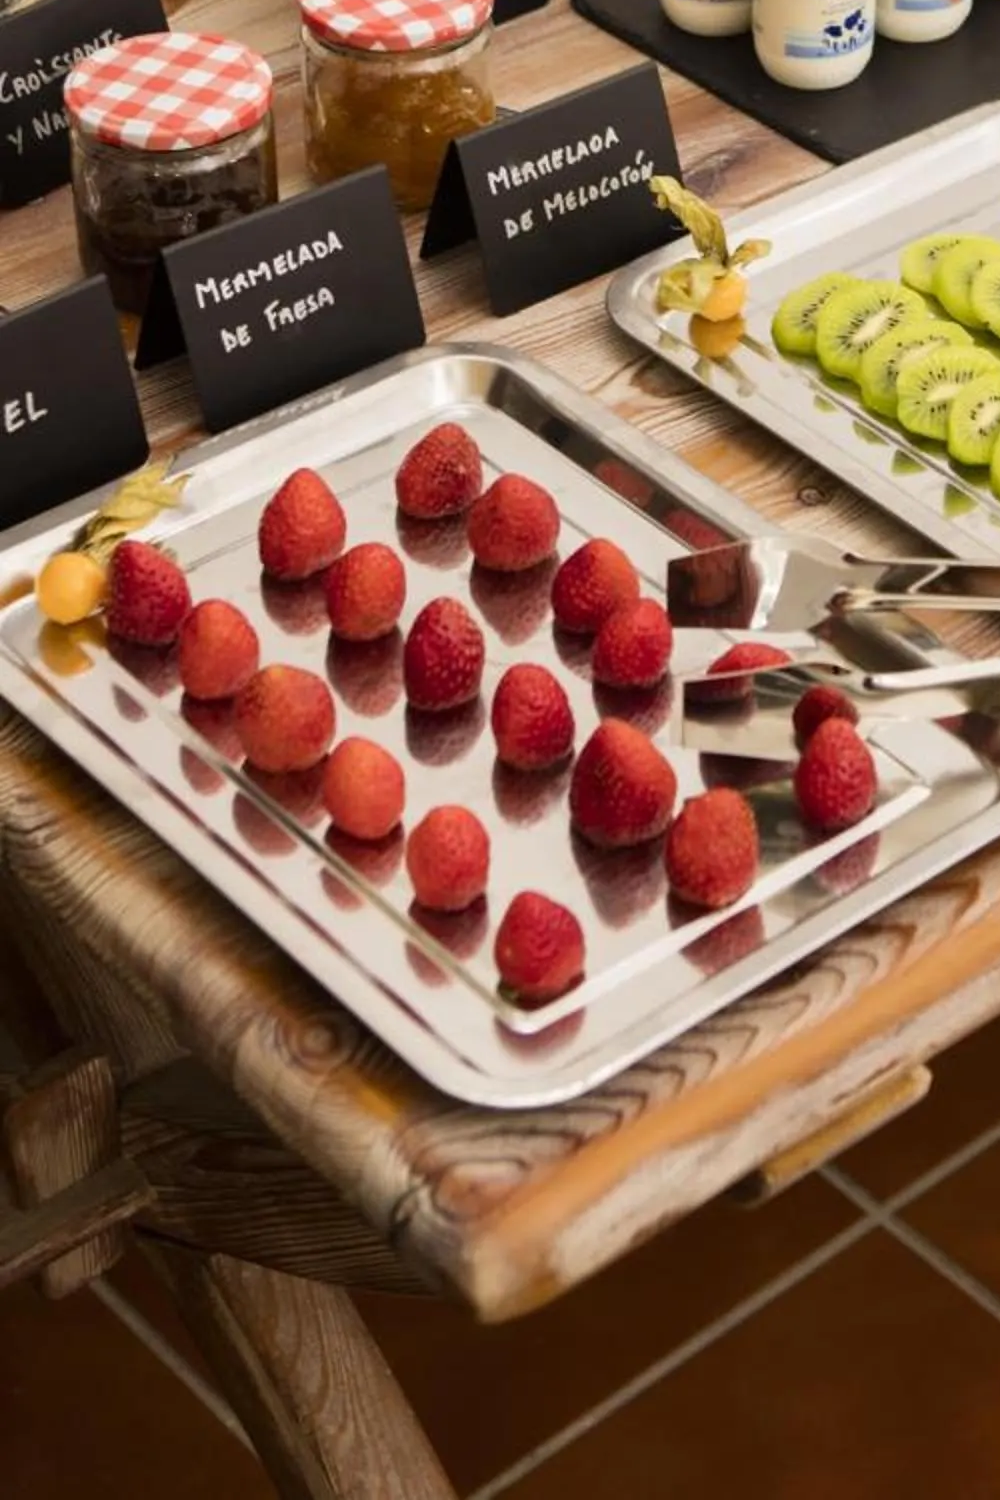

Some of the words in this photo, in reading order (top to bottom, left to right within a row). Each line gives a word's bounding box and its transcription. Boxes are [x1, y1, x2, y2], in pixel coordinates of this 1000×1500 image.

[6, 126, 23, 155] Y
[486, 125, 620, 196] MERMELADA
[503, 208, 533, 239] DE
[194, 230, 344, 309] MERMELADA
[220, 323, 253, 353] DE
[263, 286, 335, 332] FRESA
